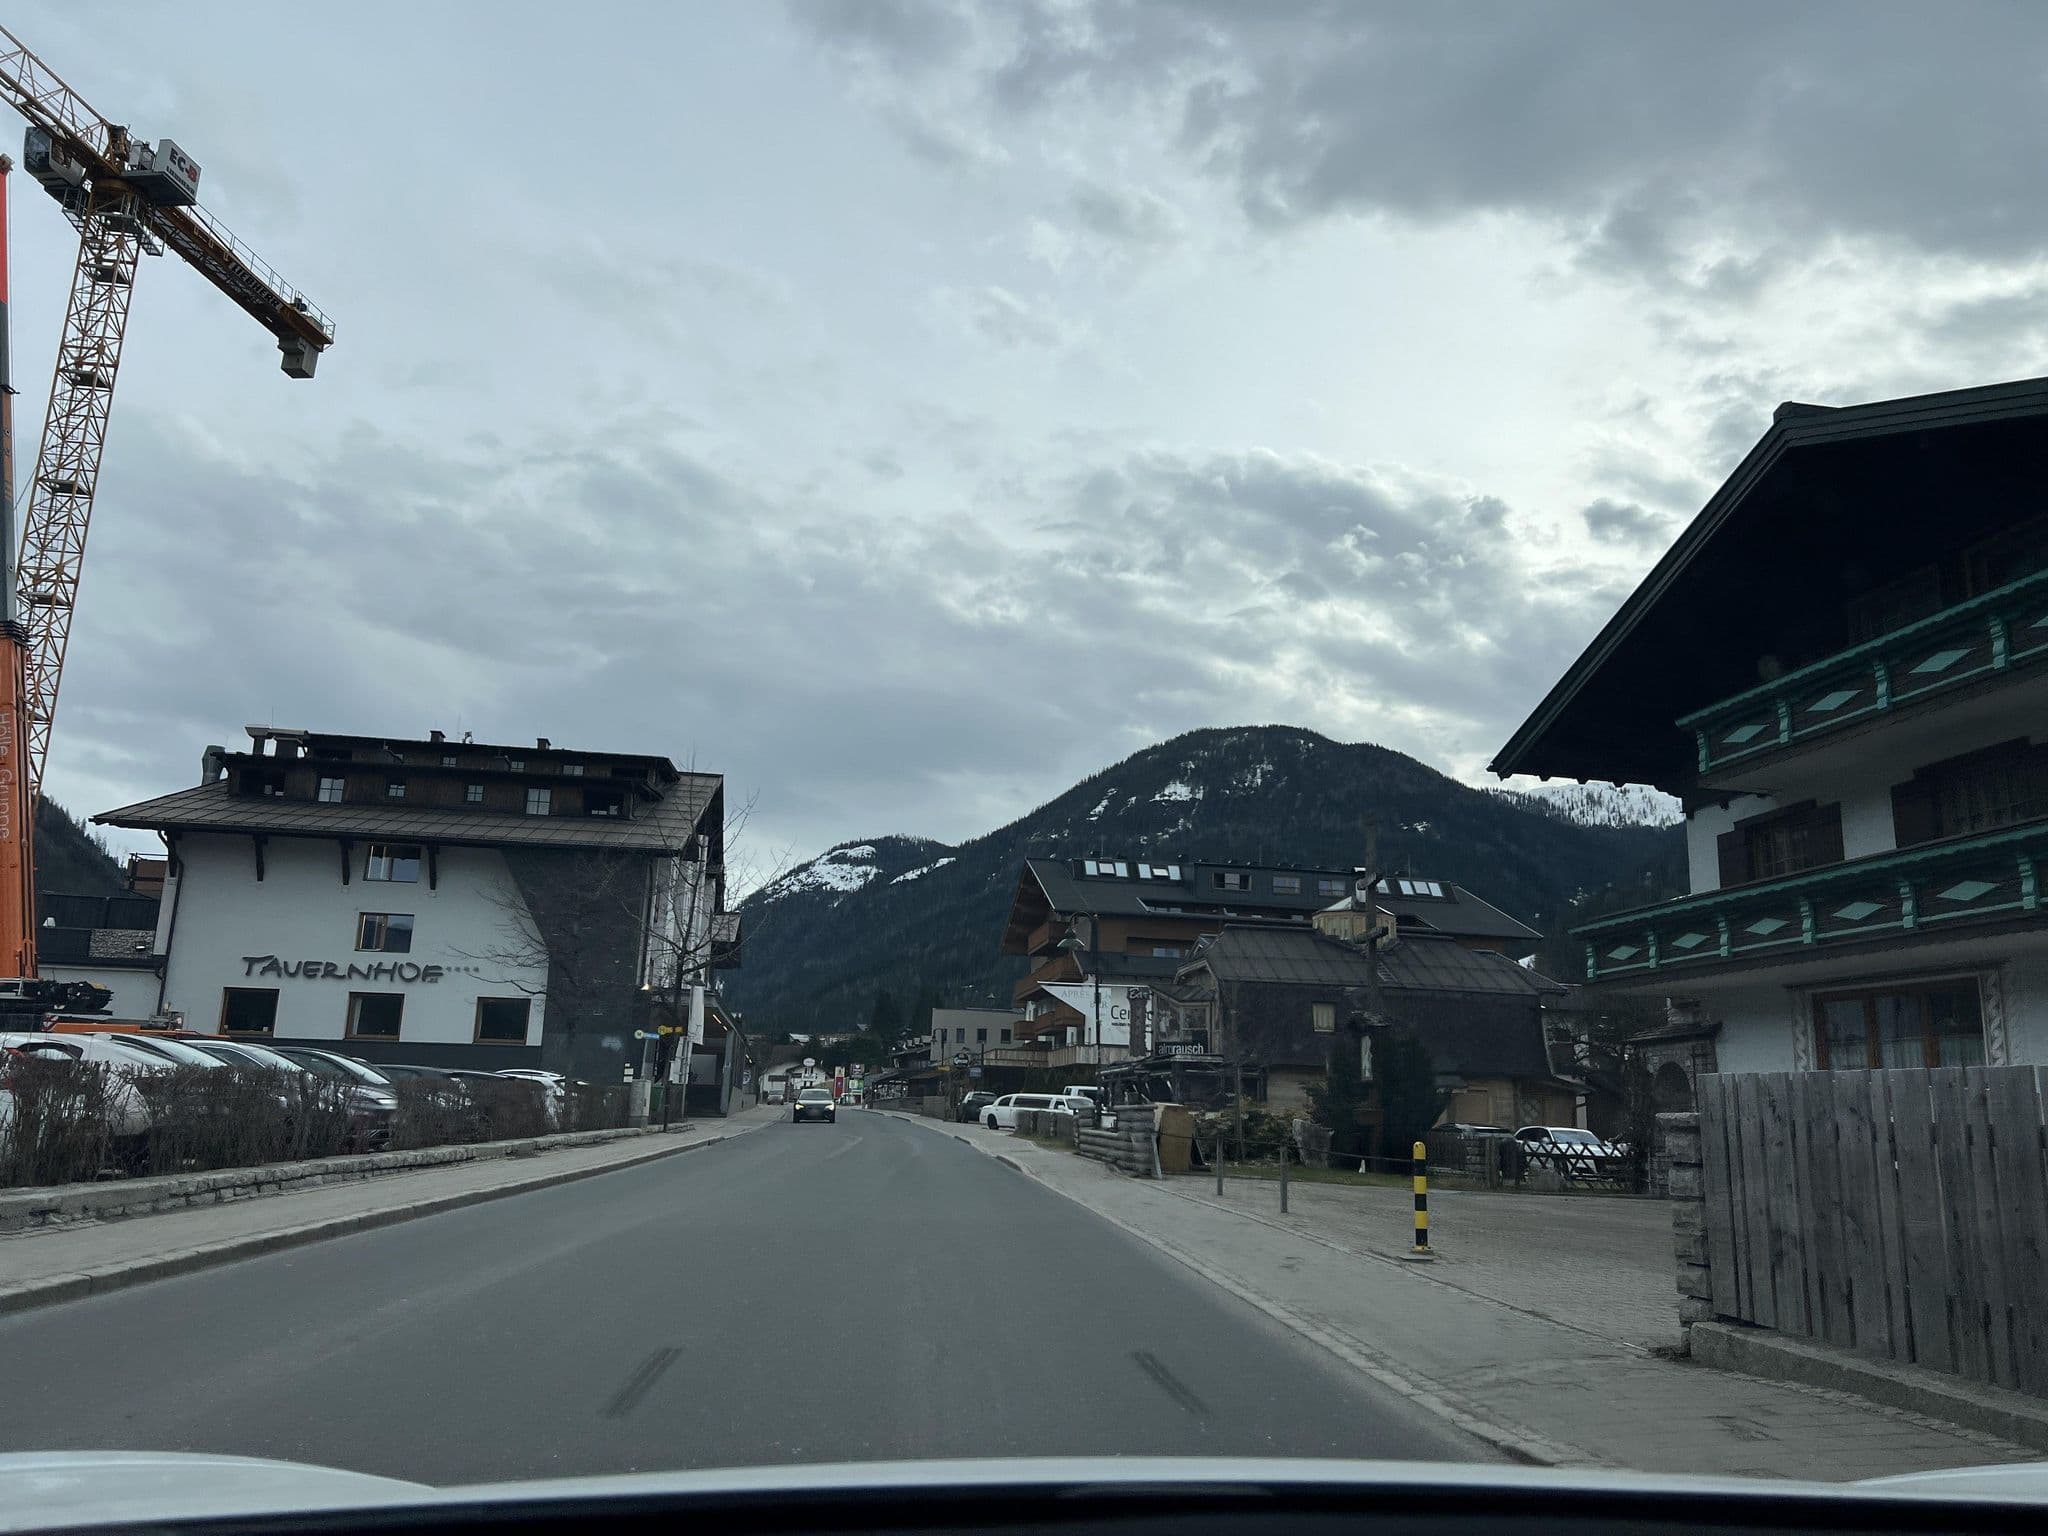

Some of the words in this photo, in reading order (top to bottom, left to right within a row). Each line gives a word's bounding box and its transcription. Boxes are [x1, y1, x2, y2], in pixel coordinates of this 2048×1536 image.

[169, 147, 198, 183] EC-B
[231, 262, 281, 309] LIEBHERR
[242, 954, 443, 983] TAUERNHOF
[1158, 1043, 1204, 1055] almrausch
